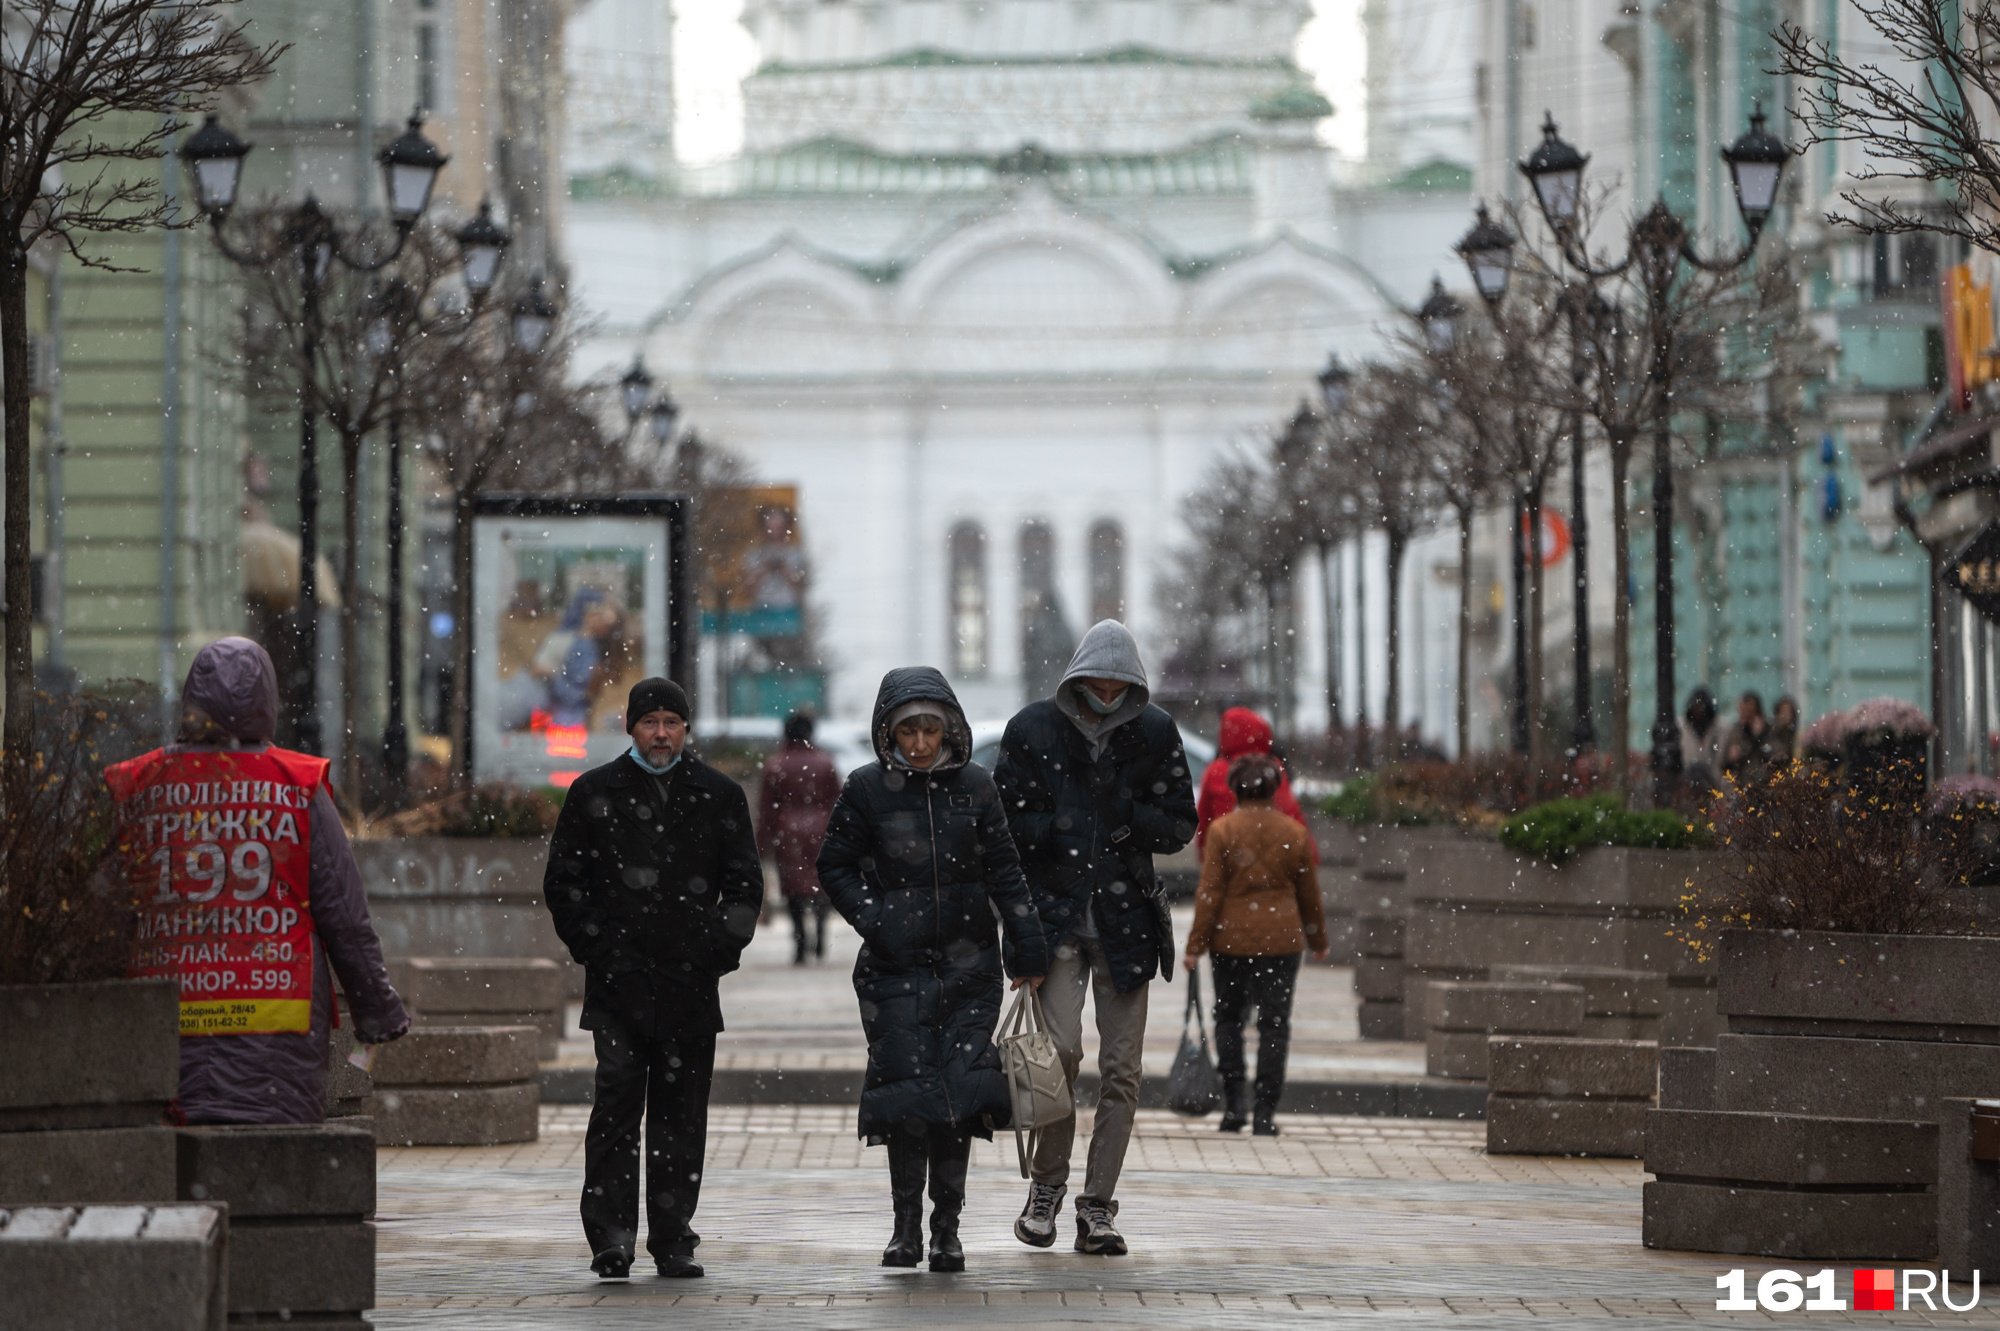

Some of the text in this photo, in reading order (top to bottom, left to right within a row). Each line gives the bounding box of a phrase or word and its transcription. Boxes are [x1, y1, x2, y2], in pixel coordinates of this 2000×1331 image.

[120, 780, 309, 820] РЮЛЬНИКЪ
[134, 809, 301, 849] ТРИЖКА
[150, 840, 272, 903] 199
[137, 905, 298, 940] МАНИКЮР
[179, 1004, 256, 1018] оборный, 28/45
[203, 1017, 248, 1028] 151-62-32
